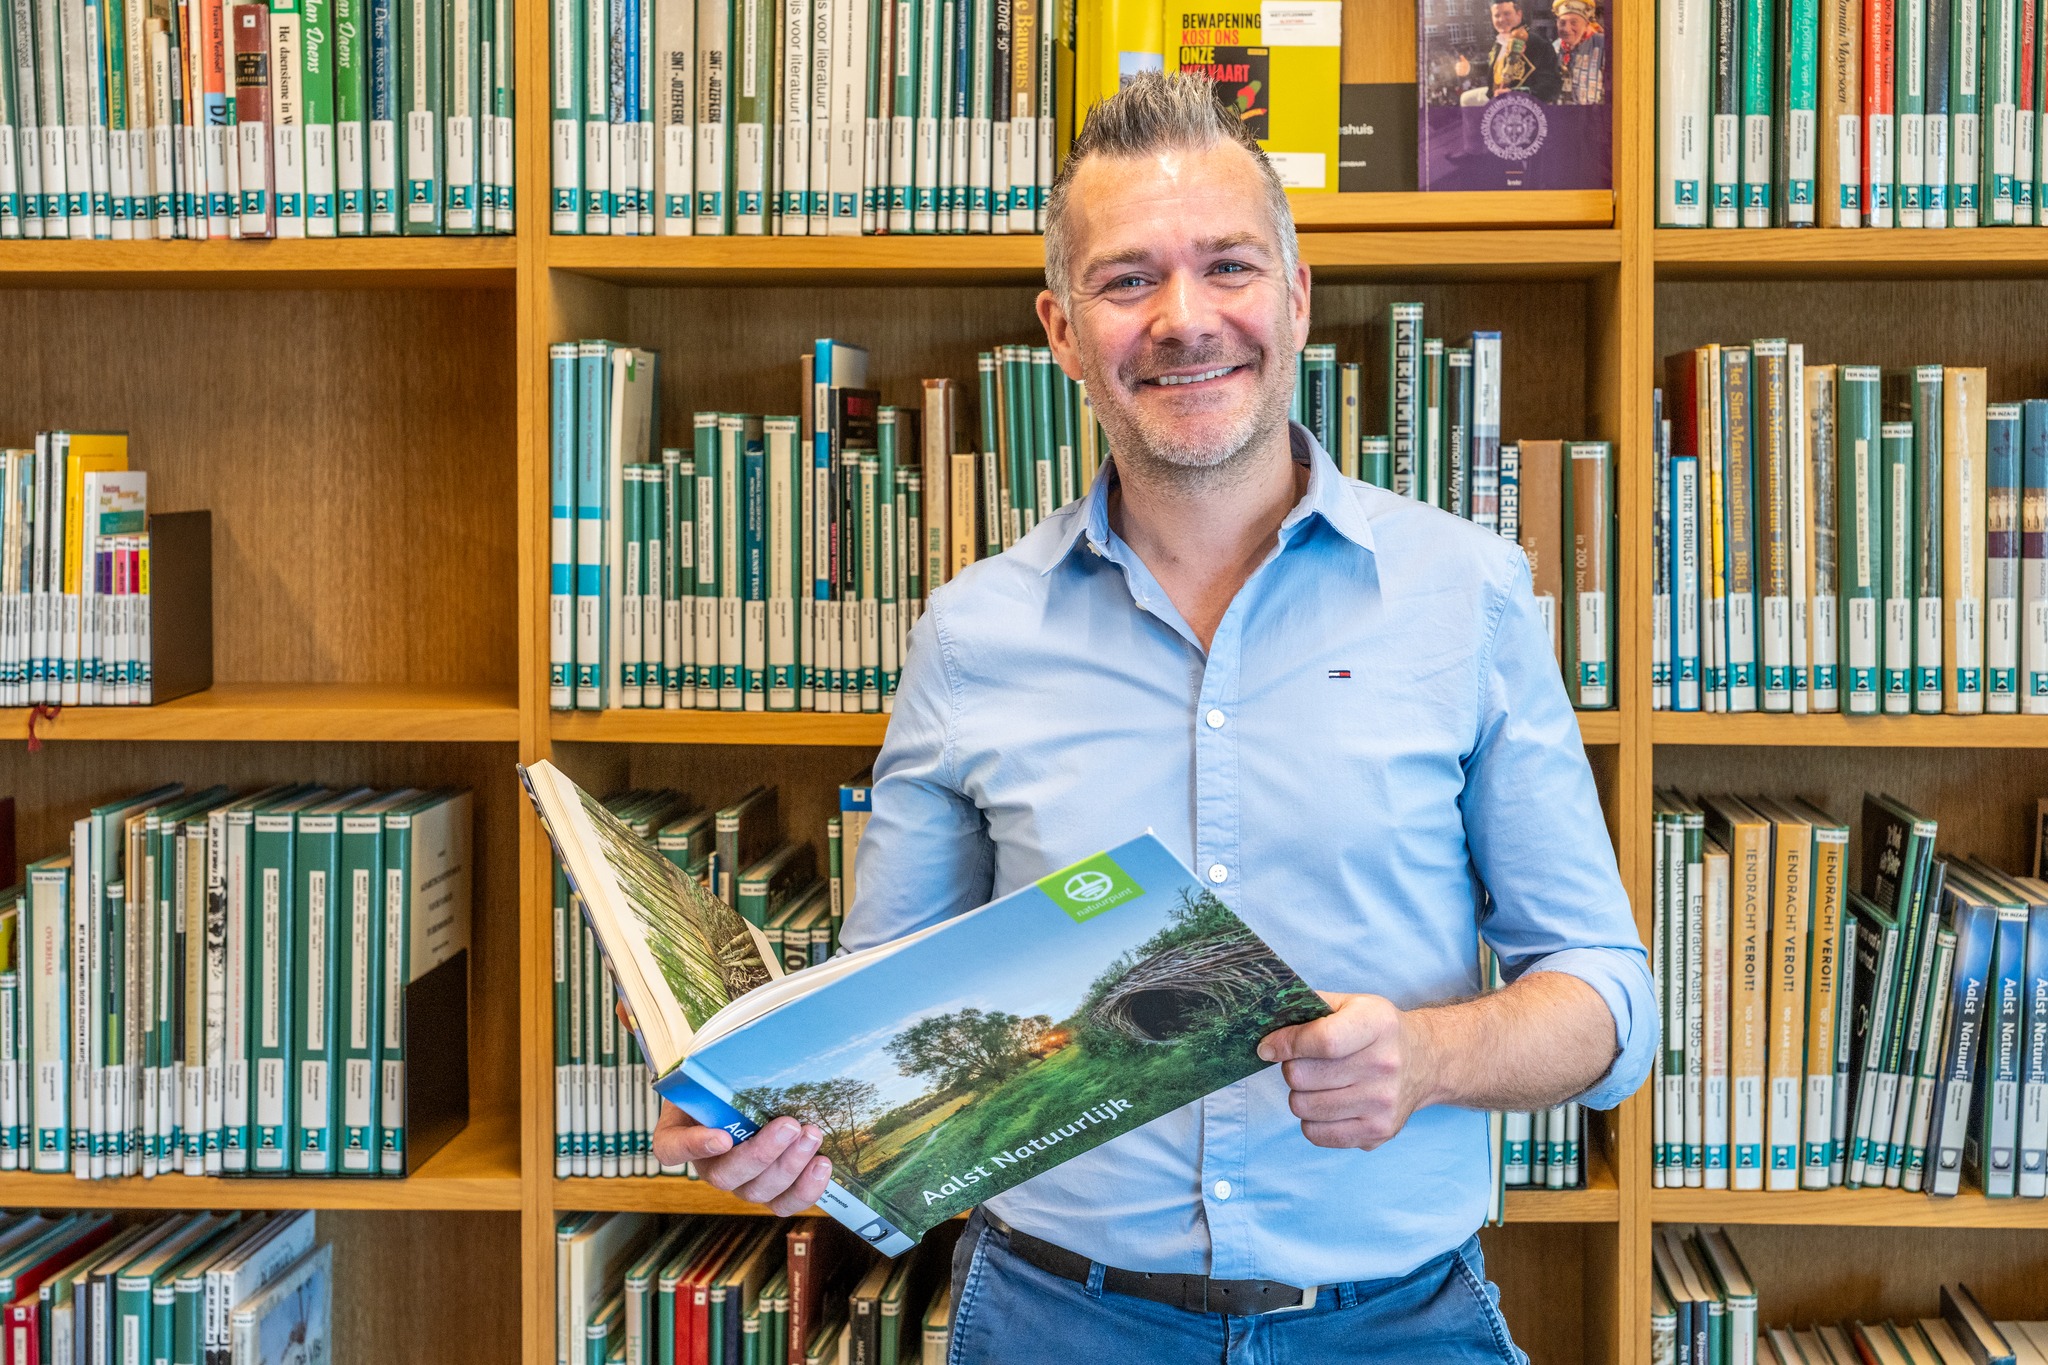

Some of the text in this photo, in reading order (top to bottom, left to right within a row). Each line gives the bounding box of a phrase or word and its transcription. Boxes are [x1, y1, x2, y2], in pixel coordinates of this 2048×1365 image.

[338, 22, 357, 69] Daens
[375, 8, 388, 40] Daens
[816, 14, 828, 45] voor
[1182, 13, 1262, 29] BEWAPENING
[1182, 29, 1239, 45] KOST ONS
[1884, 23, 1892, 36] IN
[1884, 38, 1892, 53] DE
[278, 26, 293, 114] Het daensisme in
[305, 27, 325, 74] Daens
[789, 20, 804, 115] voor literatuur
[1015, 14, 1034, 89] Bauwens
[1181, 47, 1215, 65] ONZE
[1836, 39, 1851, 104] Moyersoen
[670, 51, 685, 125] SINT-JOZEFKERK
[708, 50, 722, 124] SINT-JOZEFKERK
[816, 48, 830, 109] literatuur
[1801, 65, 1811, 87] van
[1396, 321, 1416, 476] KERAMIEK
[1449, 425, 1464, 515] Herman Muys en
[1500, 446, 1517, 479] HET
[1731, 391, 1745, 543] Sint-Maarteninstituut
[1768, 381, 1784, 533] Sint-Maarteninstituut
[930, 527, 941, 552] RENE
[1528, 537, 1538, 547] in
[1576, 535, 1586, 545] in
[1683, 474, 1694, 568] DIMITRI VERHULST
[1576, 546, 1586, 568] 200
[1076, 887, 1134, 917] natuurpunt
[1745, 848, 1757, 931] IENDRACHT
[1786, 849, 1799, 932] IENDRACHT
[1824, 850, 1838, 932] IENDRACHT
[45, 926, 53, 977] OVERHAM
[1744, 934, 1756, 992] VEROIT!
[1784, 935, 1796, 993] VEROIT!
[1820, 936, 1833, 993] VEROIT!
[1690, 895, 1703, 1076] Eendracht Aalst 1995-20
[1964, 977, 1980, 1015] Aalst
[2002, 977, 2017, 1015] Aalst
[2034, 977, 2048, 1015] Aalst
[724, 1121, 754, 1142] Aal
[922, 1098, 1134, 1206] Aalst Natuurlijk
[826, 1190, 849, 1210] gemeente
